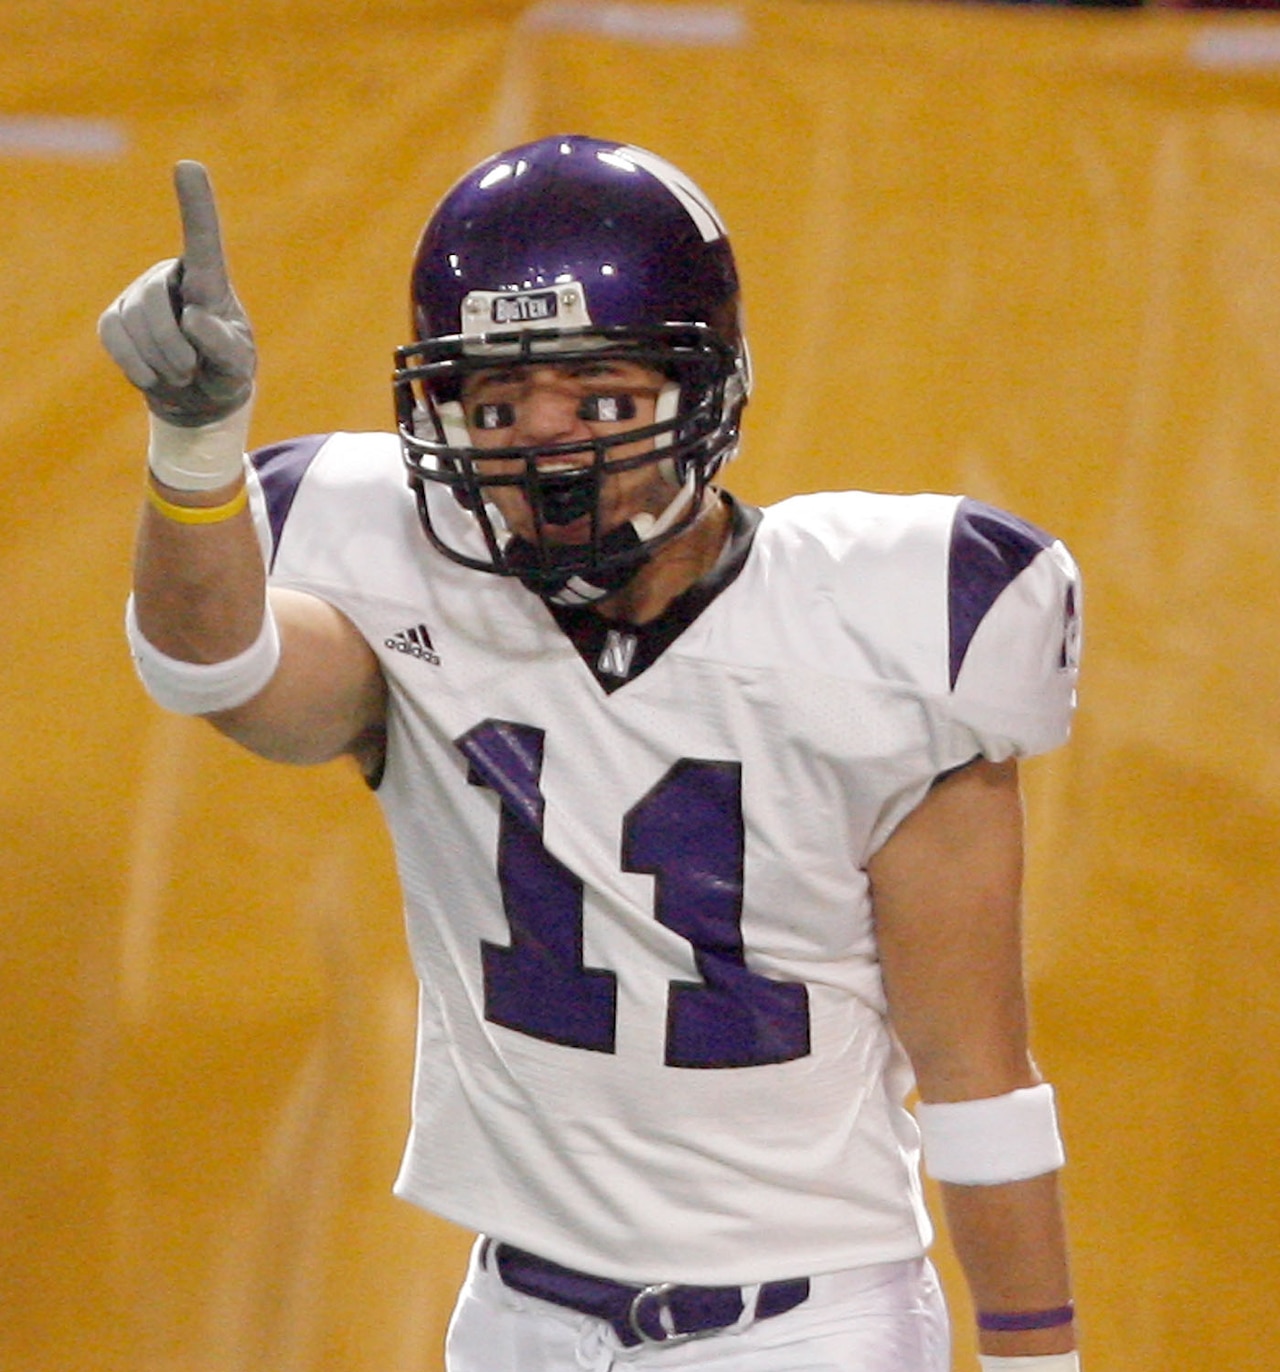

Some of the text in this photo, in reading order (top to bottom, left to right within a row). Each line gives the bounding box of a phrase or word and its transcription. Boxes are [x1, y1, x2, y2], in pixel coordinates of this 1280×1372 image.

[384, 639, 441, 667] adidas
[598, 630, 638, 678] N
[453, 718, 811, 1069] 11
